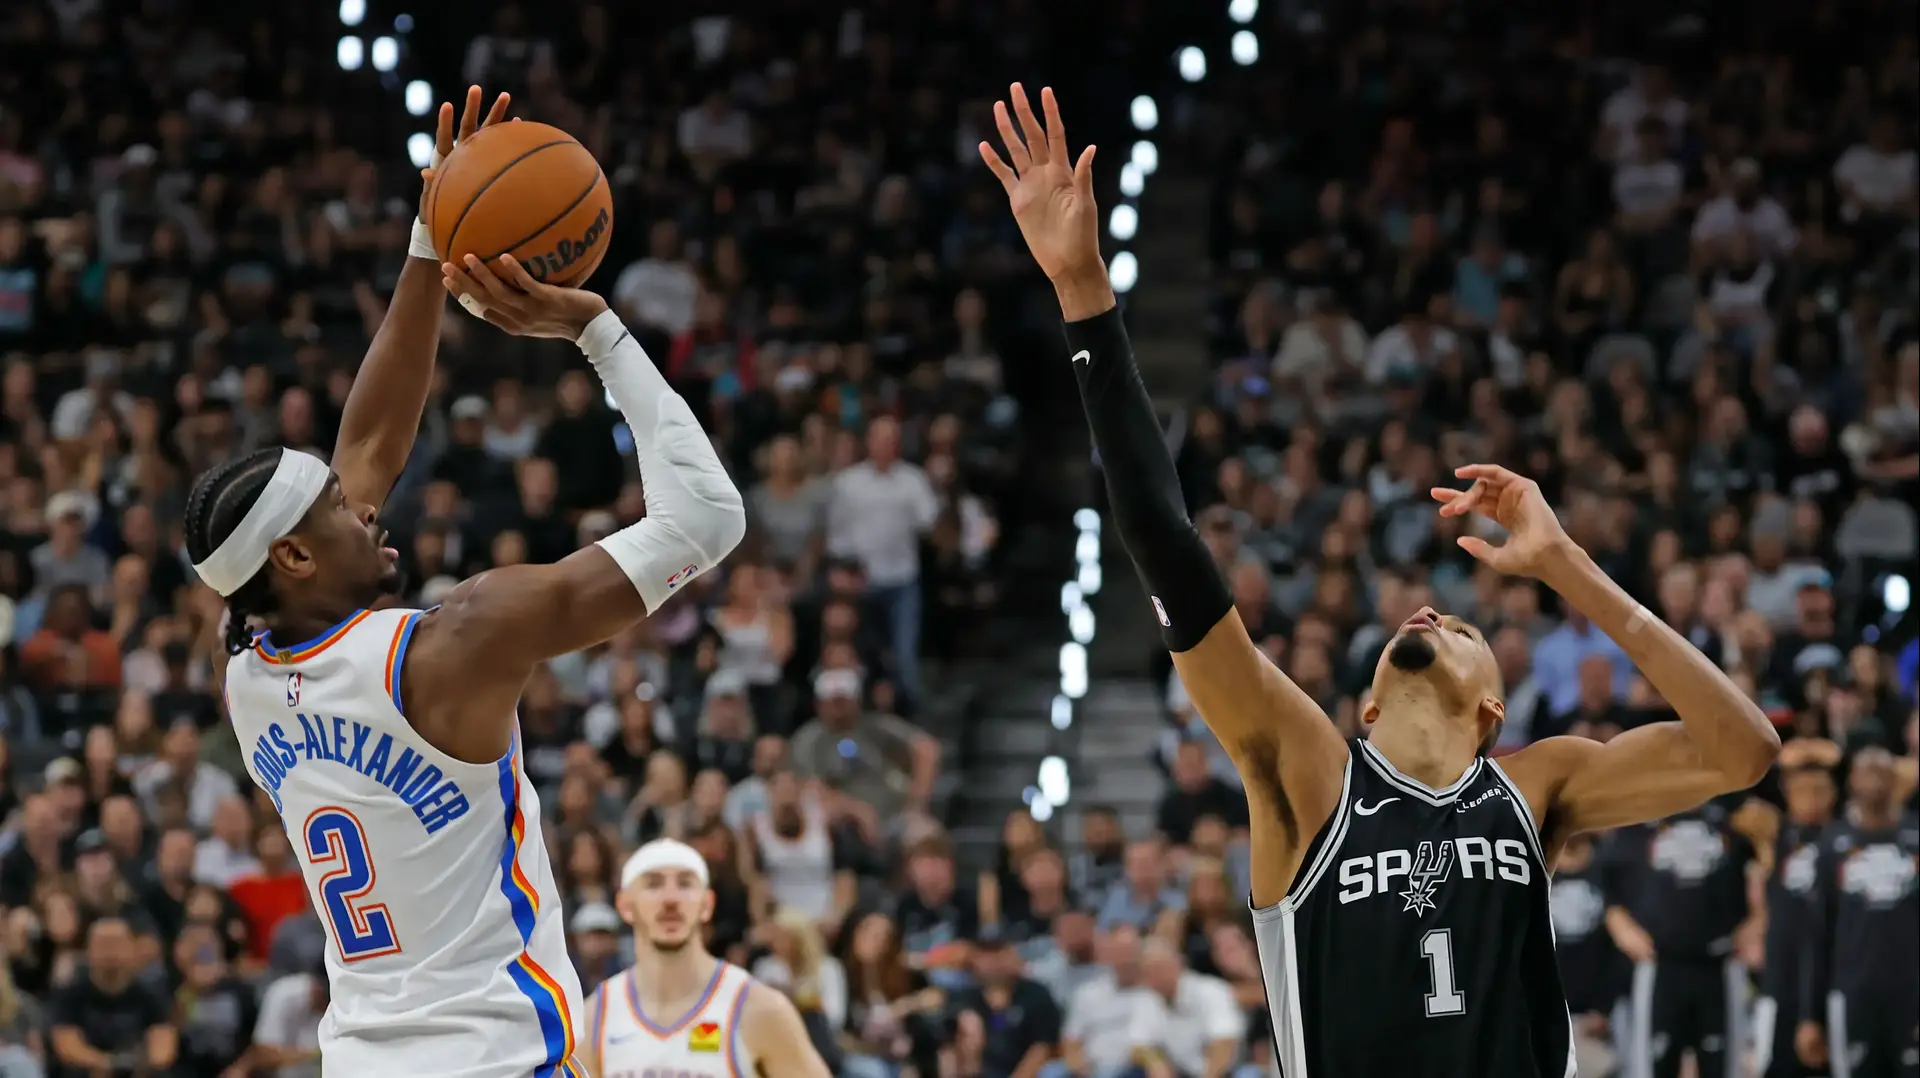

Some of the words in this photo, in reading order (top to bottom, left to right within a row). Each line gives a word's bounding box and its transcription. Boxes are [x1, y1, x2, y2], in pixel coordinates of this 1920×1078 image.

[253, 713, 470, 835] OUS-ALEXANDER
[1462, 788, 1502, 809] LEDGER
[303, 806, 402, 963] 2
[1339, 836, 1531, 918] SPURS
[1419, 927, 1467, 1018] 1
